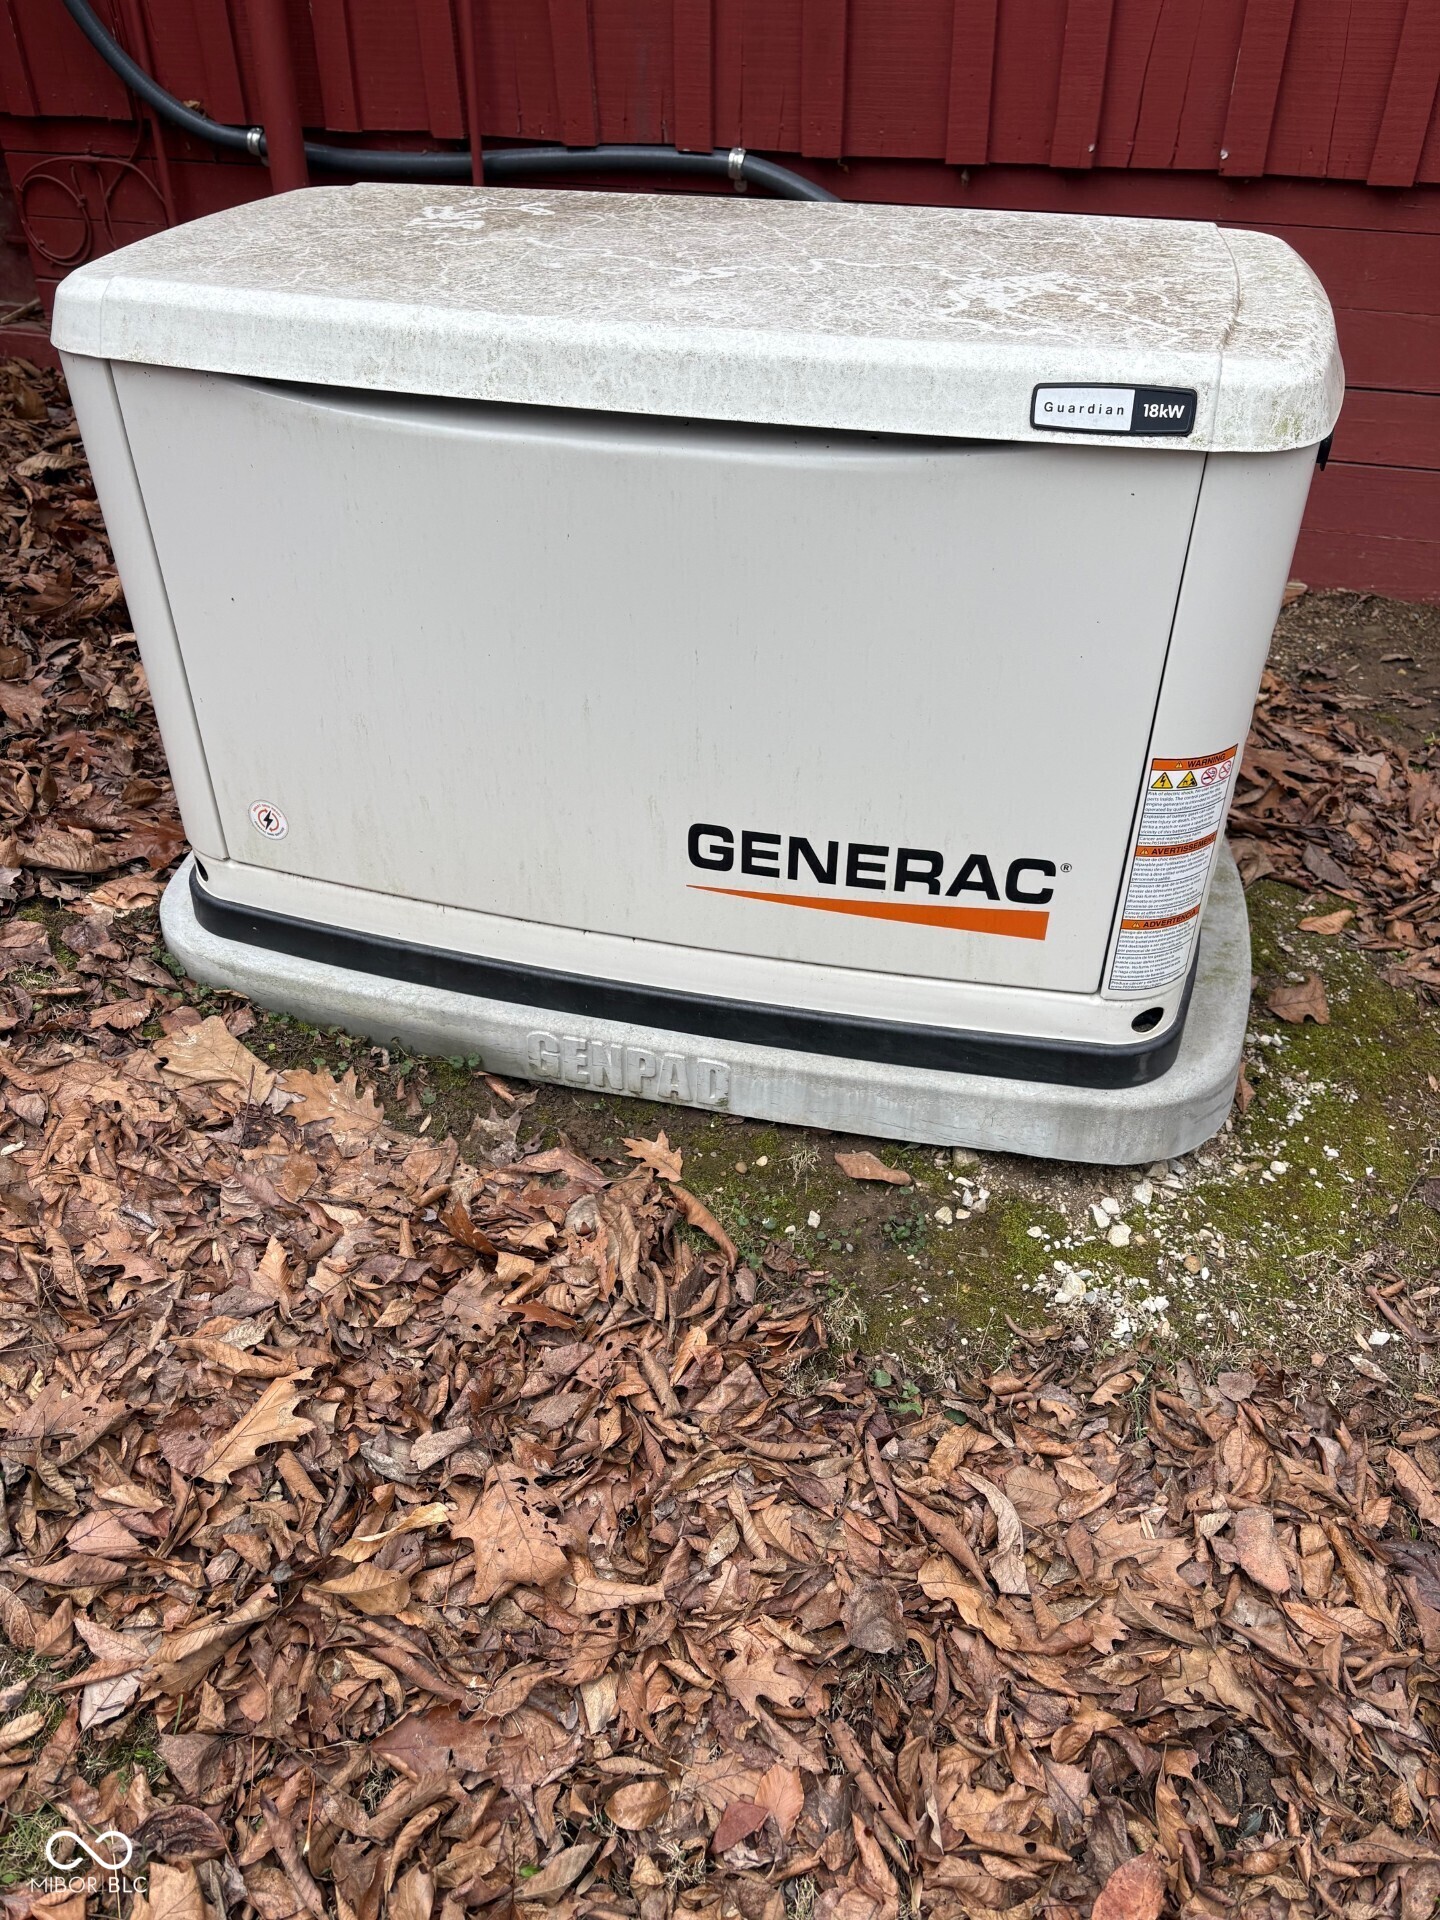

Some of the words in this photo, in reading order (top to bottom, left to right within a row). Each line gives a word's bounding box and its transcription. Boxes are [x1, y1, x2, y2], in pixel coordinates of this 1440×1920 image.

[1043, 401, 1125, 416] Guardian
[1143, 403, 1186, 419] 18kW
[1187, 753, 1226, 768] WARNING
[1151, 834, 1216, 855] AVERTISSEMENT
[1143, 910, 1196, 928] ADVERTENCIA
[526, 1030, 732, 1106] GENPAD
